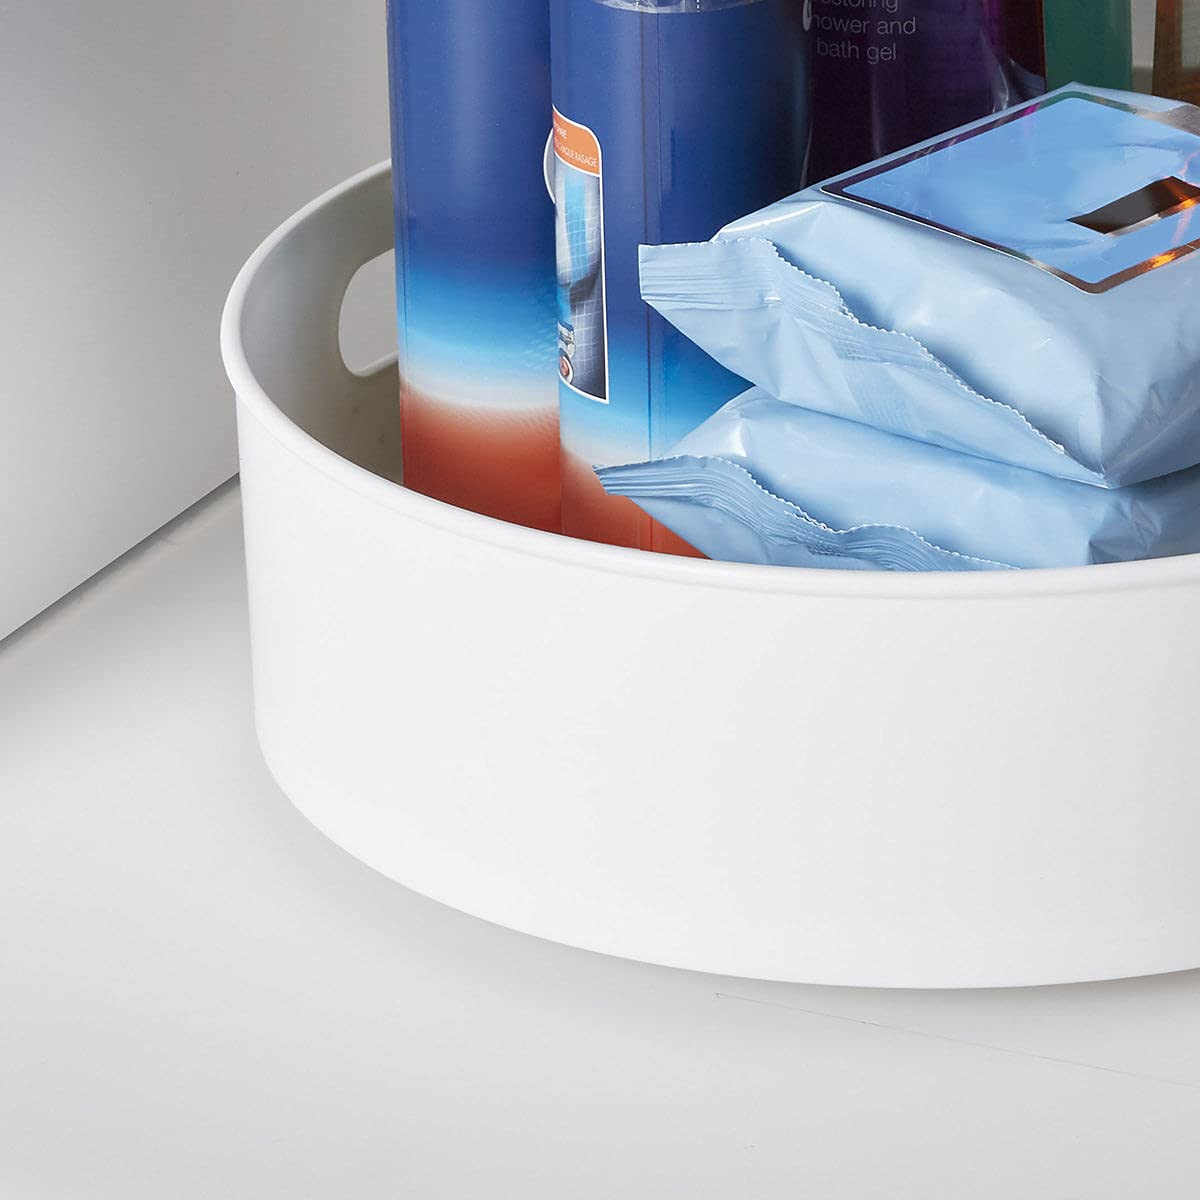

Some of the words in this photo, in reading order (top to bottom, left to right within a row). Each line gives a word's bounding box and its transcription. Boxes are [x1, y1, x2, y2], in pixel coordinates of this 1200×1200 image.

[811, 13, 871, 34] ower
[876, 16, 917, 35] and
[816, 36, 860, 60] bath
[866, 43, 897, 64] gel
